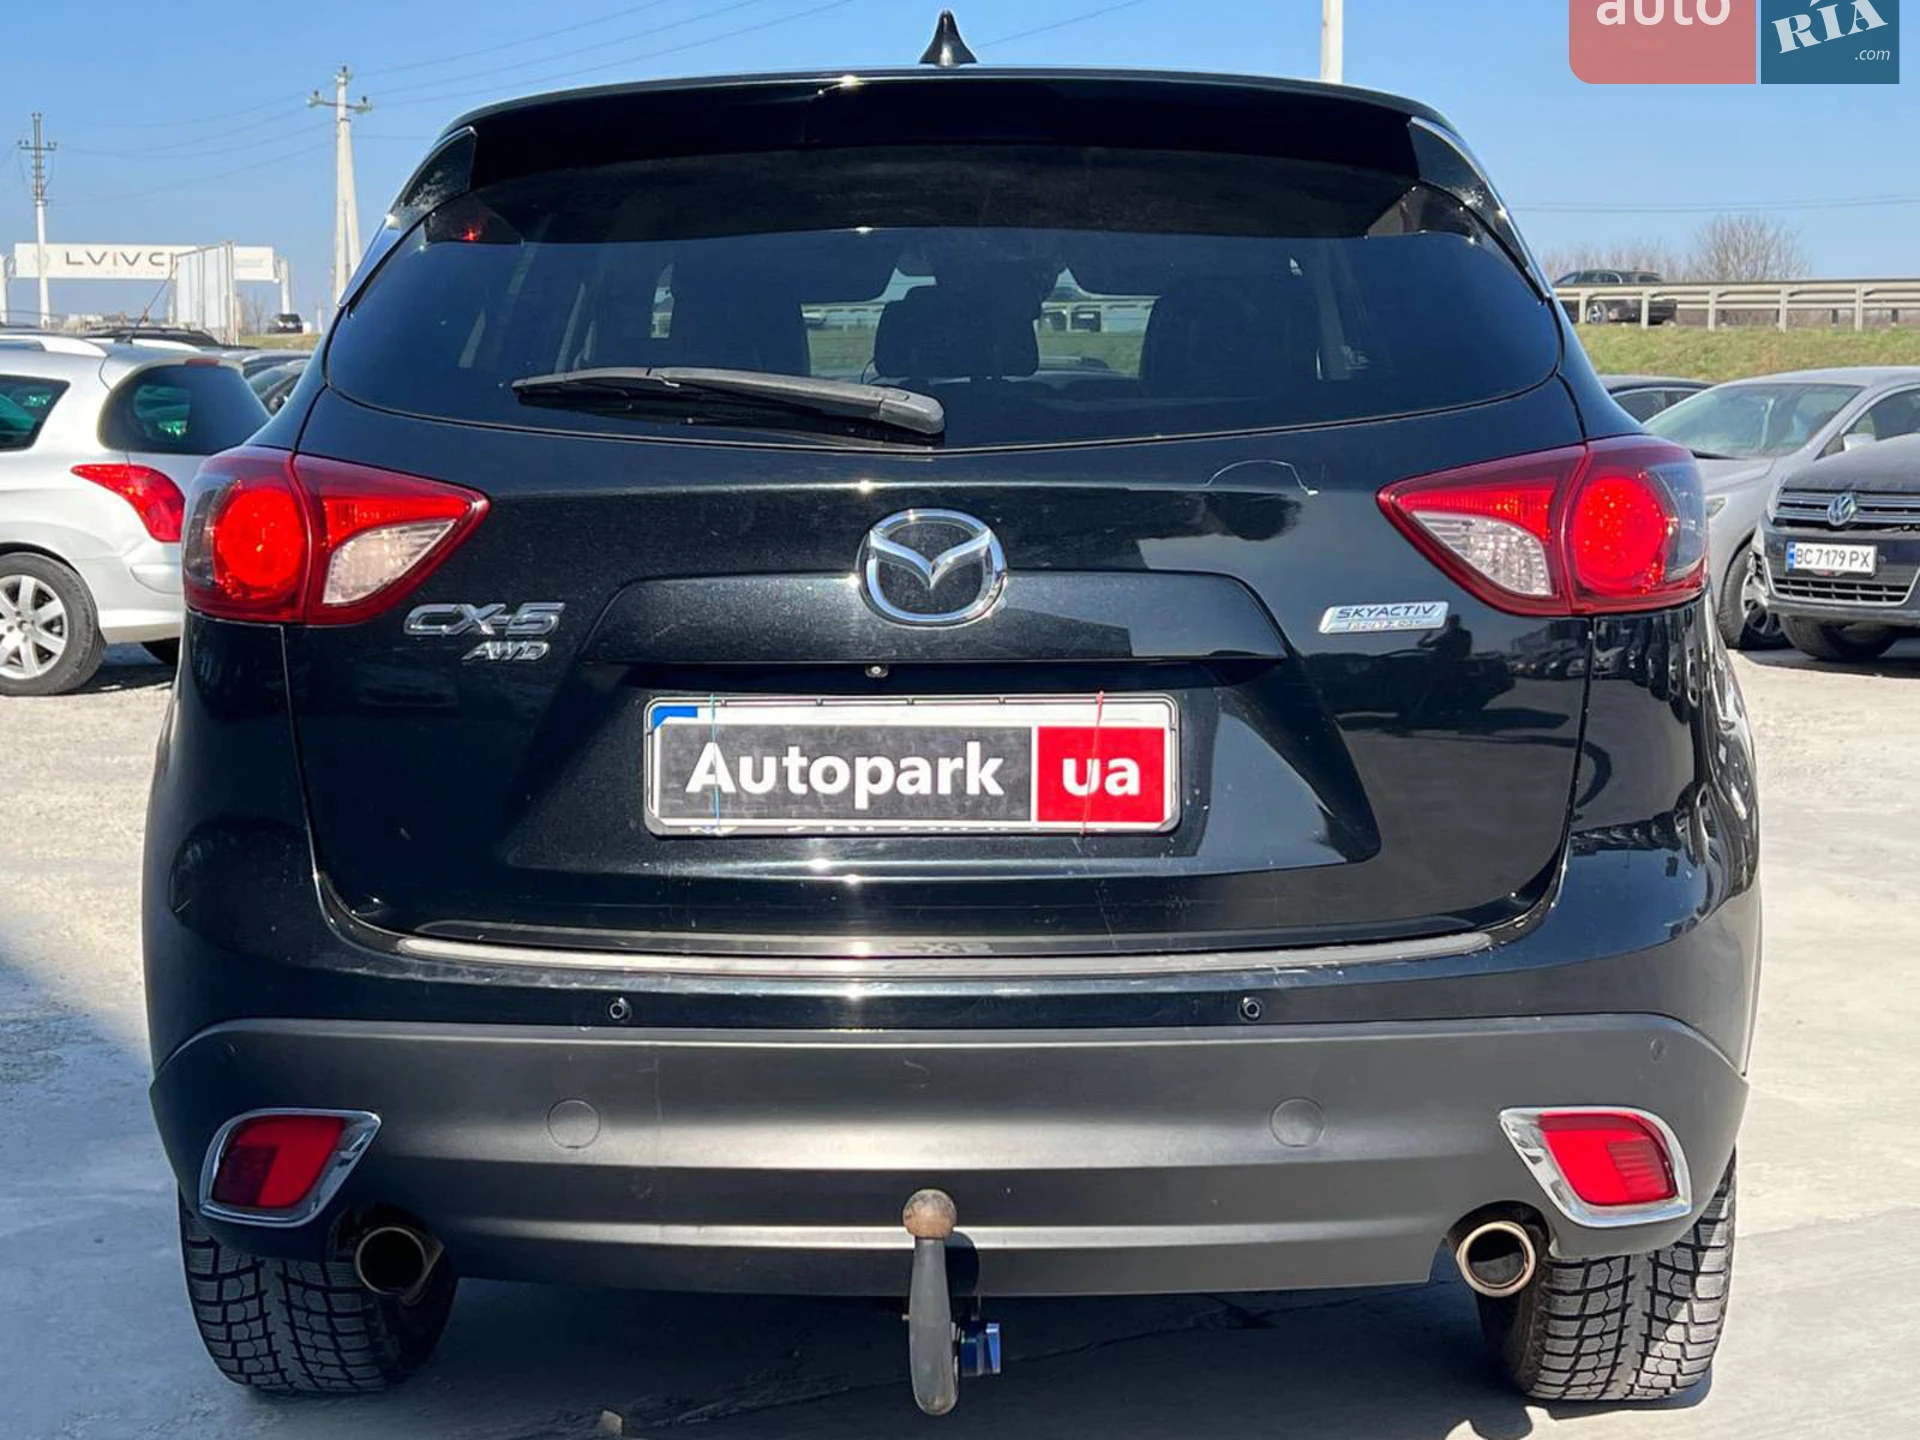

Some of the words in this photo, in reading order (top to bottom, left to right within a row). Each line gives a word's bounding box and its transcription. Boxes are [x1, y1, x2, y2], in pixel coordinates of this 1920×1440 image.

[403, 602, 566, 636] CX-5
[1336, 603, 1438, 619] SKYACTIV
[460, 640, 551, 662] AWD
[686, 740, 1004, 810] Autopark
[1062, 756, 1141, 797] ua
